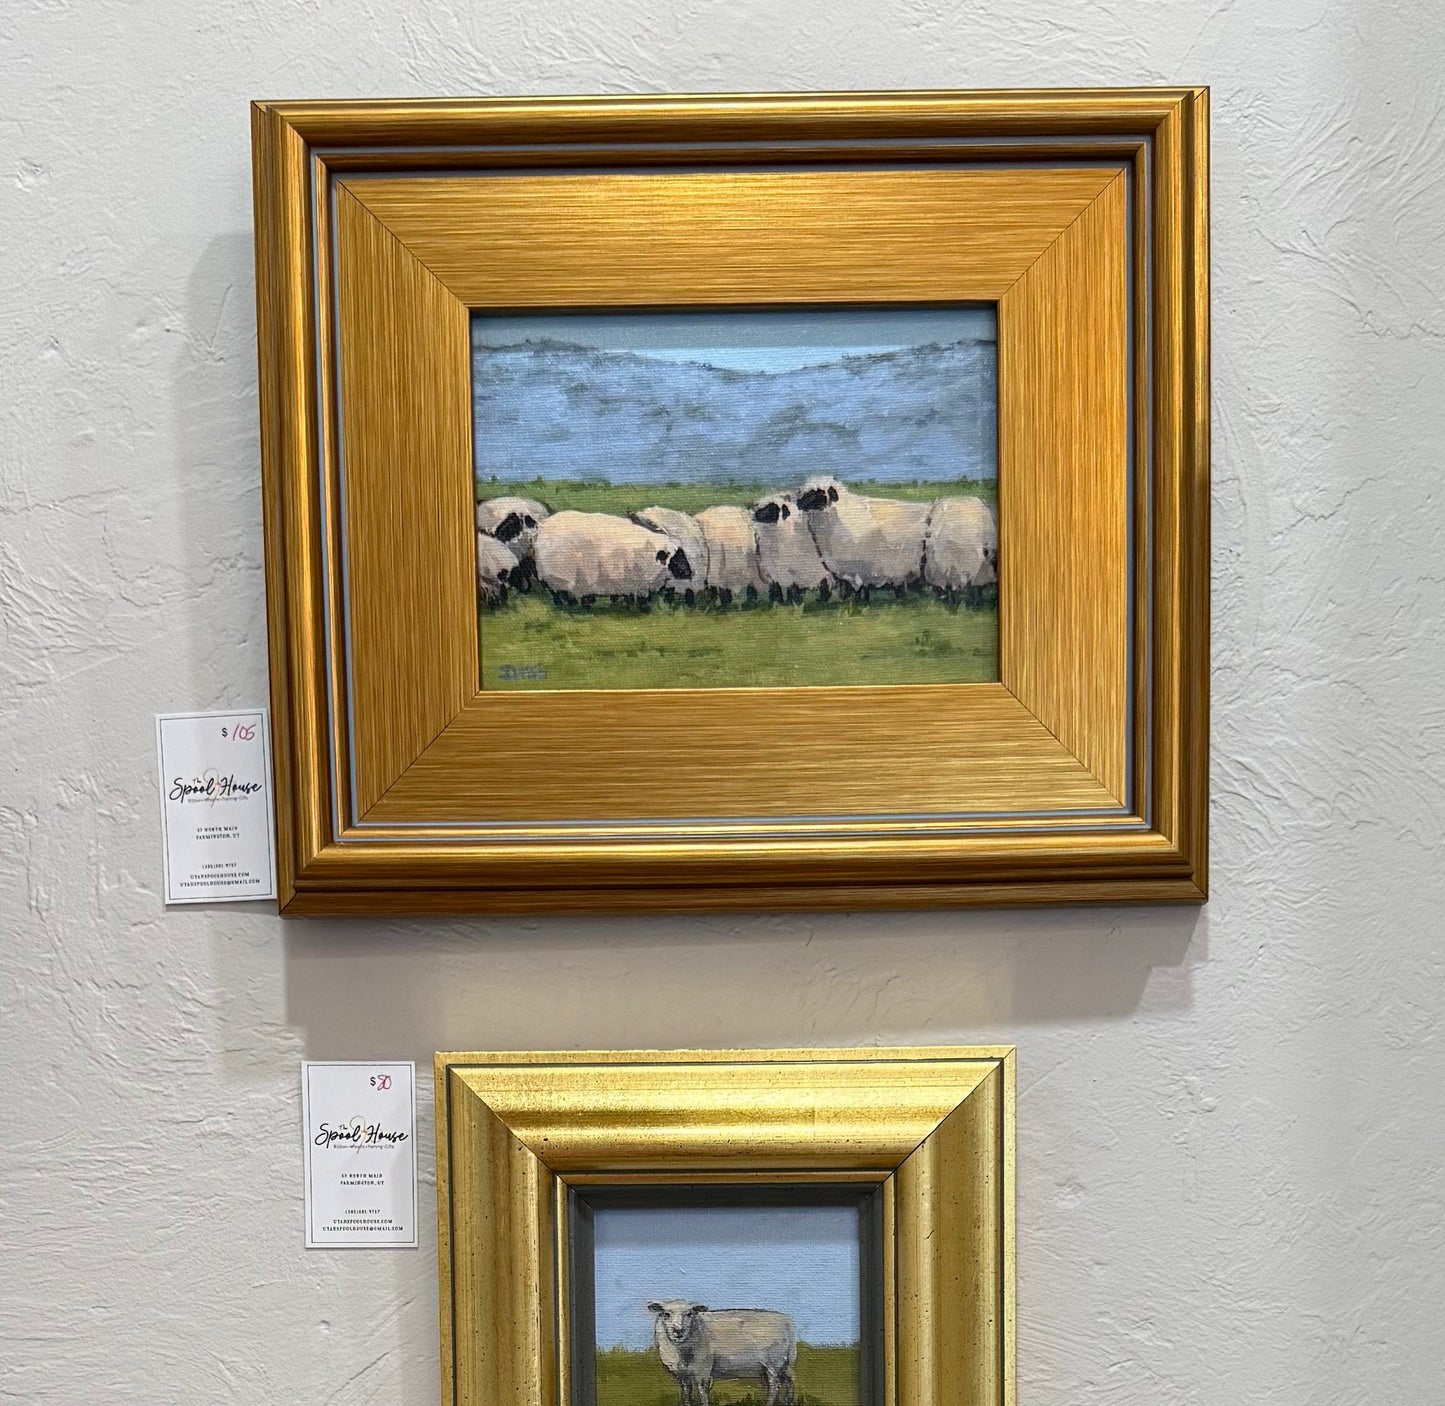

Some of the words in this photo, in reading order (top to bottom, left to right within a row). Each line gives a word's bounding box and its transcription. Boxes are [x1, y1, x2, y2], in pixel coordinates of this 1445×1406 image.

[169, 777, 215, 803] Spool
[219, 774, 262, 797] House
[315, 1123, 361, 1149] Spool
[365, 1122, 408, 1144] House
